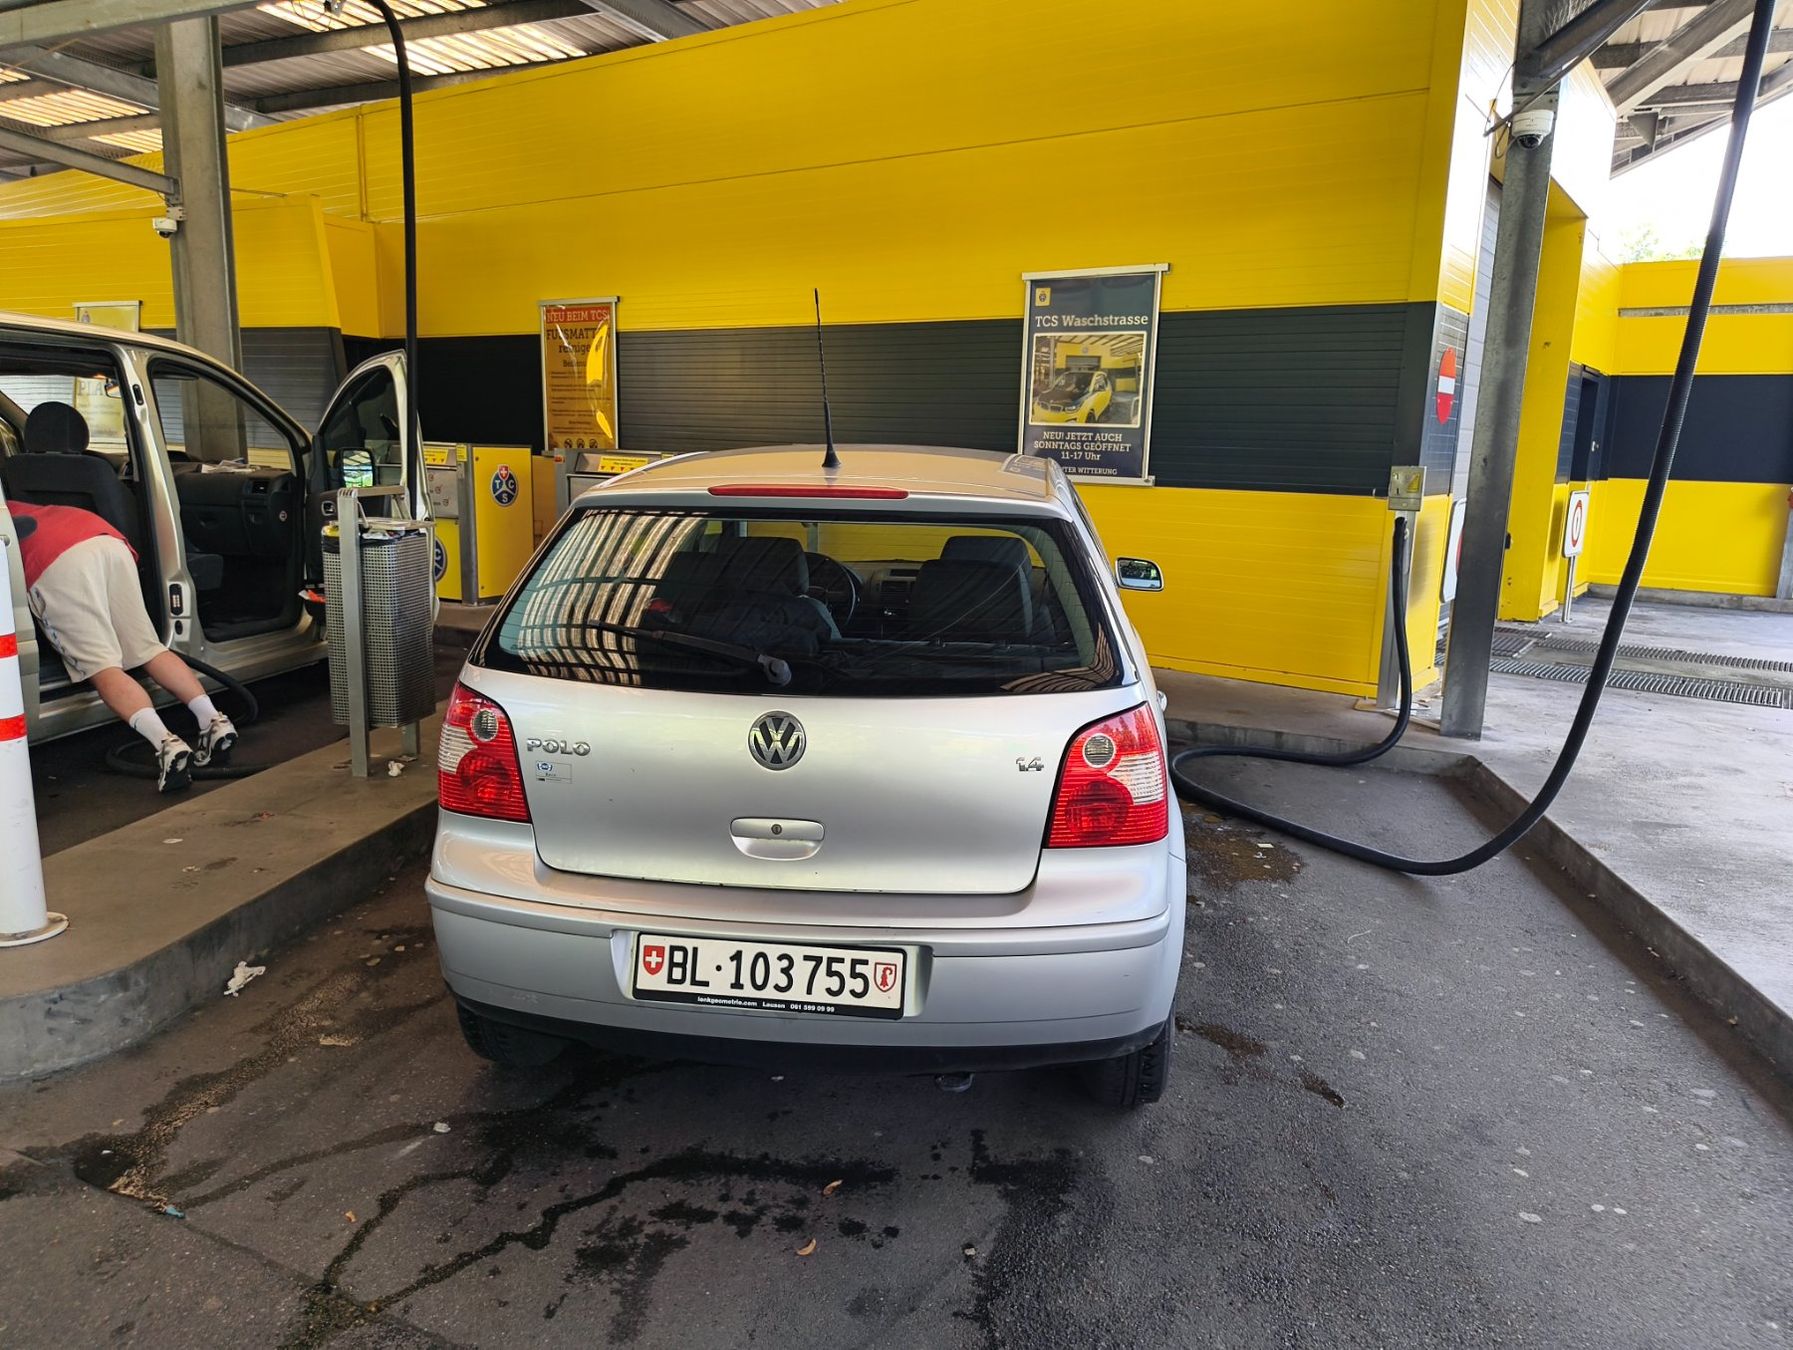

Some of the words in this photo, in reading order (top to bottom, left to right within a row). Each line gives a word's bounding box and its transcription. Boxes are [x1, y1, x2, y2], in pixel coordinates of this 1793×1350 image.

[546, 311, 565, 322] NEU
[567, 310, 589, 321] BEIM
[1035, 315, 1059, 327] TCS
[1062, 314, 1149, 327] Waschstrasse
[1065, 432, 1094, 441] JETZT
[1095, 433, 1123, 442] AUCH
[1034, 440, 1081, 450] SONNTAGS
[1061, 451, 1082, 460] 11-17
[1085, 452, 1101, 461] Uhr
[1078, 467, 1118, 475] WITTERUNG
[526, 738, 591, 757] POLO
